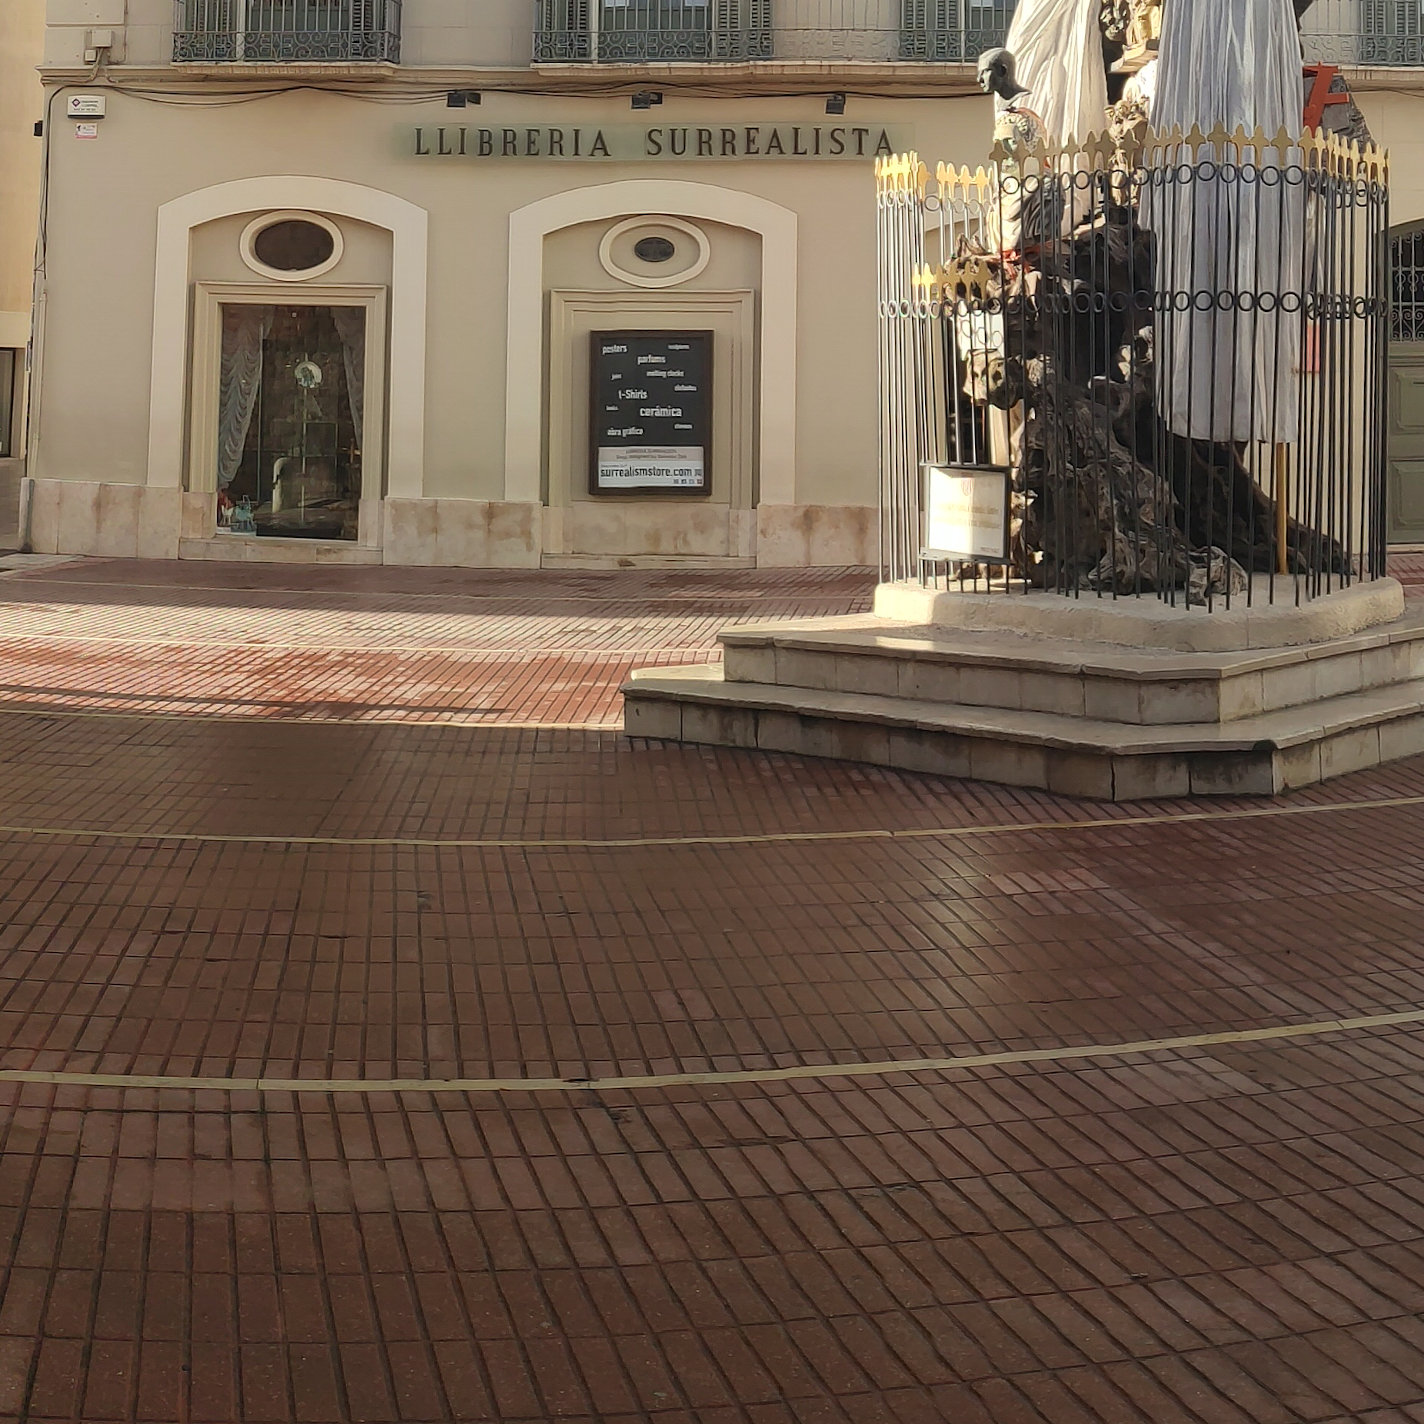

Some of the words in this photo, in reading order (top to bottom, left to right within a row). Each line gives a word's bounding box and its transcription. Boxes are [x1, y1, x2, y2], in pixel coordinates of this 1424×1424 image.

[414, 127, 612, 157] LLIBRERIA
[646, 127, 894, 156] SURREALISTA
[601, 466, 692, 477] surrealismstore.com
